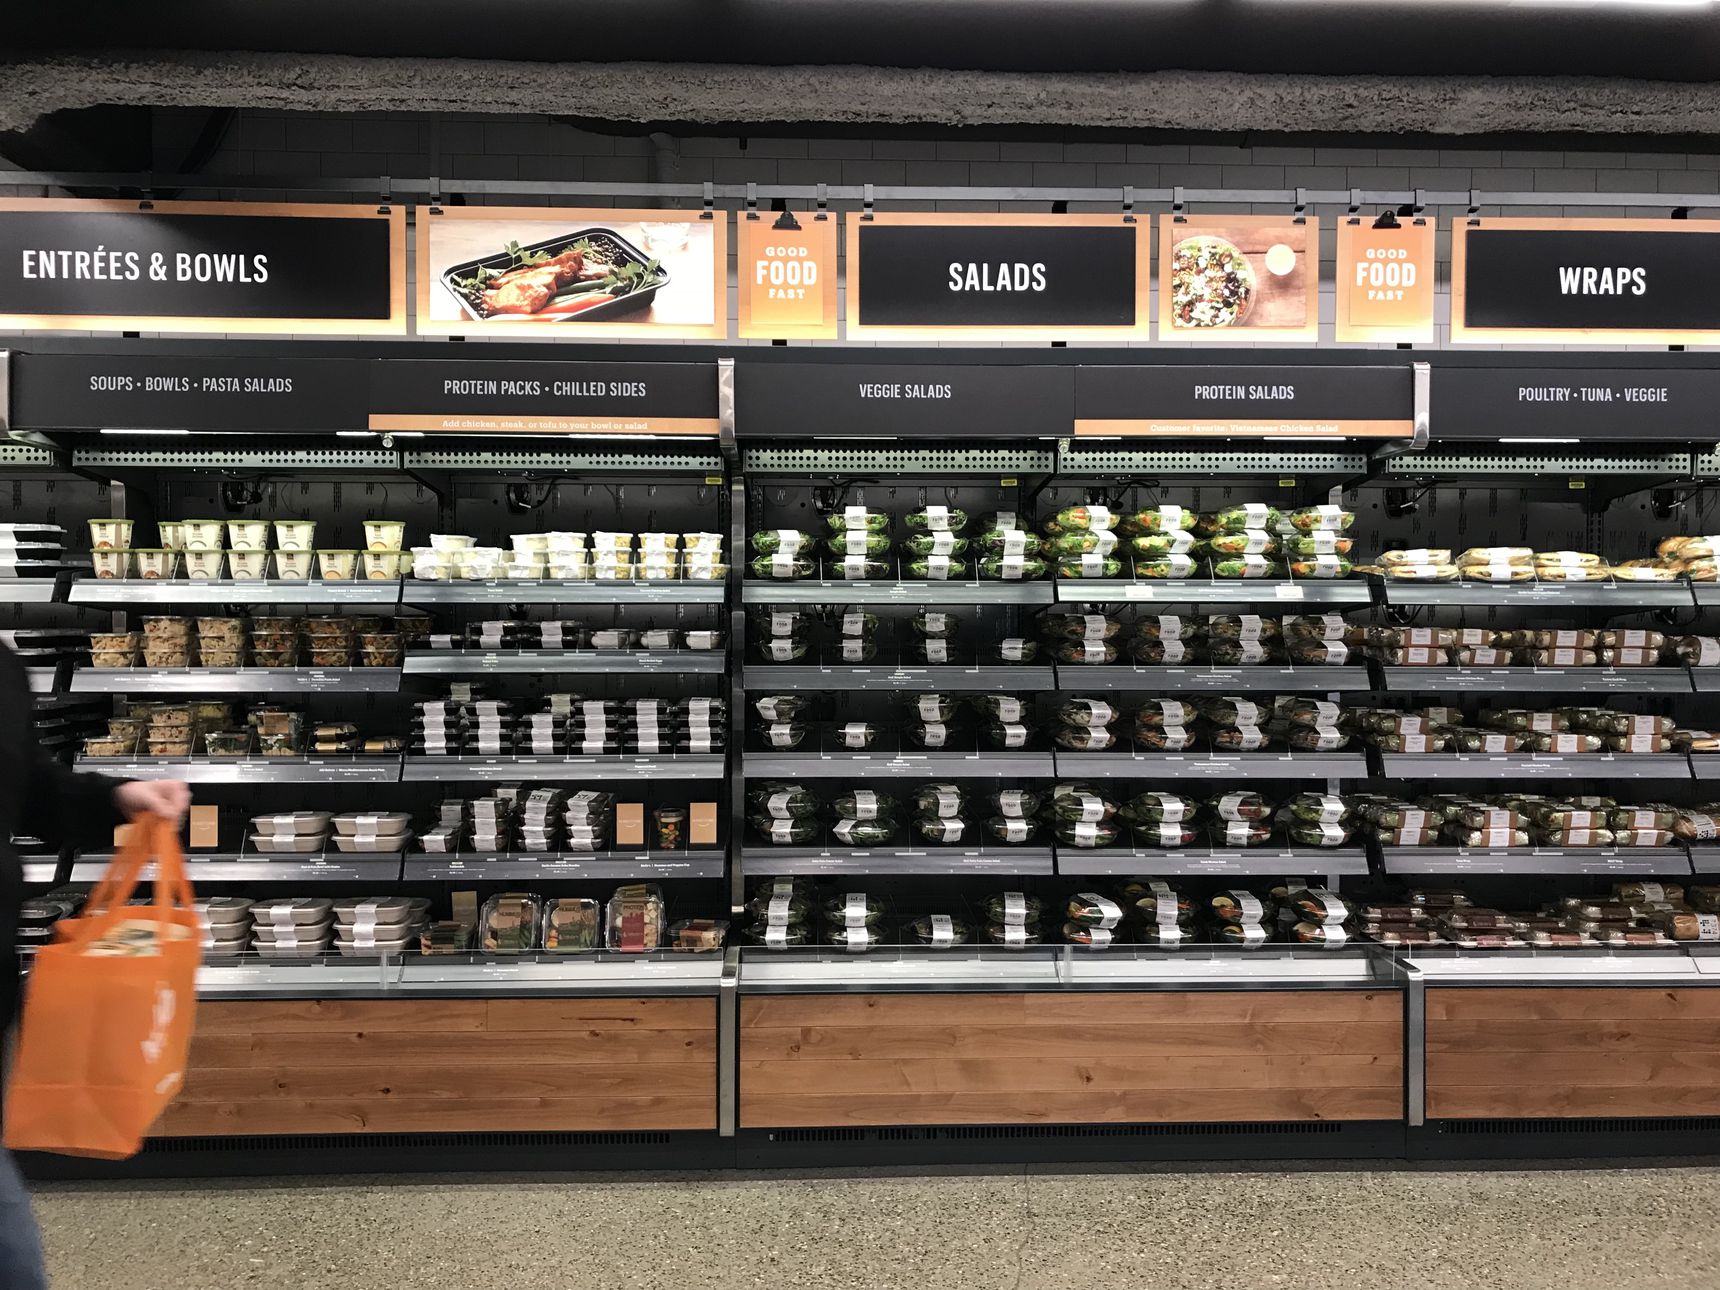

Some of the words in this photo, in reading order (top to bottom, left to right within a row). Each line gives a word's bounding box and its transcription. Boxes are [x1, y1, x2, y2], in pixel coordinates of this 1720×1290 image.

[765, 246, 808, 257] GOOD
[1366, 248, 1408, 259] GOOD
[22, 245, 141, 280] ENTRÉES
[148, 252, 168, 281] &
[176, 253, 269, 283] BOWLS
[756, 260, 817, 285] FOOD
[948, 262, 1047, 292] SALADS
[1356, 261, 1417, 287] FOOD
[1558, 266, 1647, 296] WRAPS
[768, 288, 805, 299] FAST
[1368, 290, 1404, 301] FAST
[89, 376, 133, 391] SOUPS
[145, 377, 190, 392] BOWLS
[202, 377, 241, 391] PASTA
[244, 378, 293, 393] SALADS
[444, 379, 497, 395] PROTEIN
[500, 380, 541, 395] PACKS
[553, 381, 606, 397] CHILLED
[609, 382, 647, 397] SIDES
[858, 383, 902, 399] VEGGIE
[904, 383, 952, 399] SALADS
[1194, 385, 1246, 400] PROTEIN
[1248, 385, 1295, 400] SALADS
[1518, 387, 1571, 402] POULTRY
[1580, 388, 1612, 402] TUNA
[1623, 387, 1668, 403] VEGGIE
[442, 420, 459, 428] Add
[461, 420, 499, 429] chicken,
[539, 421, 557, 429] tofu
[569, 423, 590, 431] your
[591, 421, 612, 430] bowl
[624, 422, 648, 430] salad
[1150, 424, 1190, 432] Customer
[1230, 424, 1278, 432] Vietnamese
[1279, 424, 1314, 432] Chicken
[1315, 424, 1339, 433] Salad
